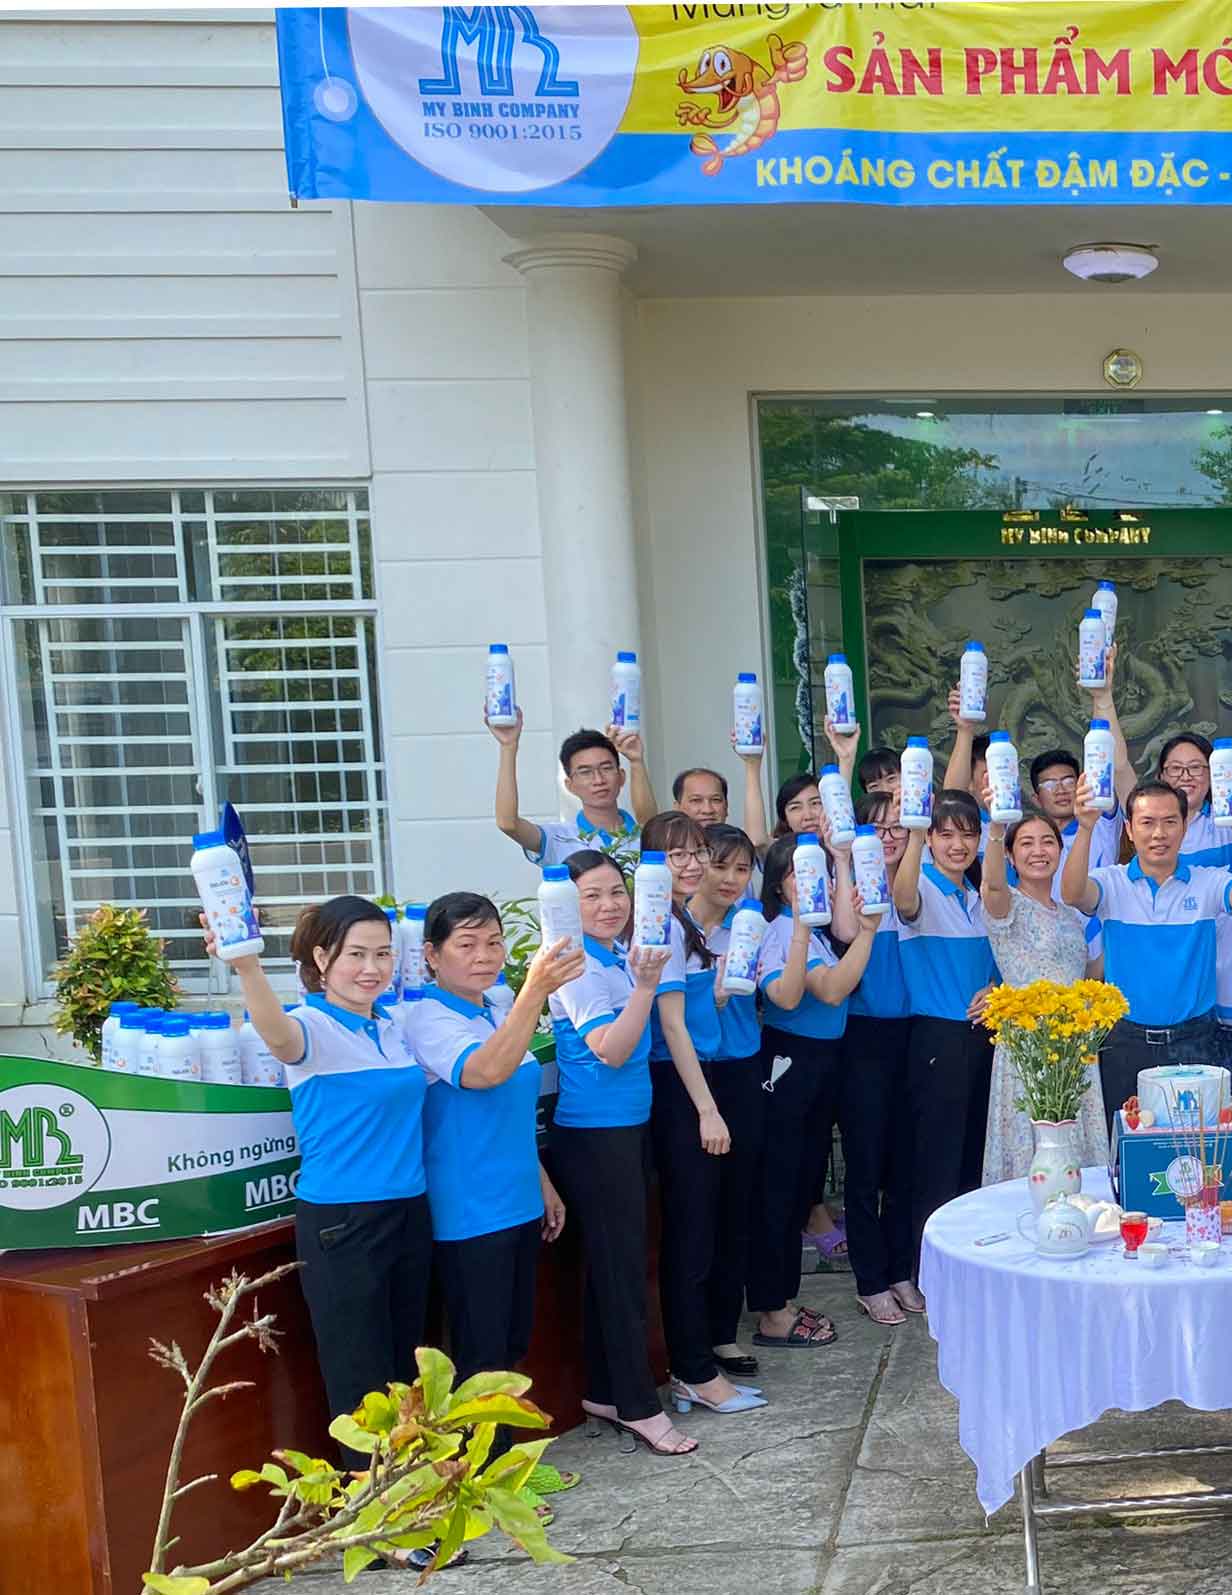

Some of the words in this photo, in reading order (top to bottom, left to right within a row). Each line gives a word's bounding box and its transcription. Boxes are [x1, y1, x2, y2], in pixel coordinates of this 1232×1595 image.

[824, 31, 944, 96] SẢN
[963, 24, 1134, 96] PHẨM
[422, 101, 446, 117] MY
[452, 102, 493, 118] BINH
[500, 103, 579, 118] COMPANY
[424, 122, 462, 139] ISO
[469, 124, 582, 140] 9001:2015
[756, 151, 916, 189] KHOÁNG
[928, 147, 1024, 189] CHẤT
[1035, 152, 1118, 196] ĐẬM
[1130, 152, 1209, 196] ĐẶC
[168, 1149, 235, 1172] Không
[240, 1136, 296, 1161] ngừng
[78, 1199, 160, 1230] MBC
